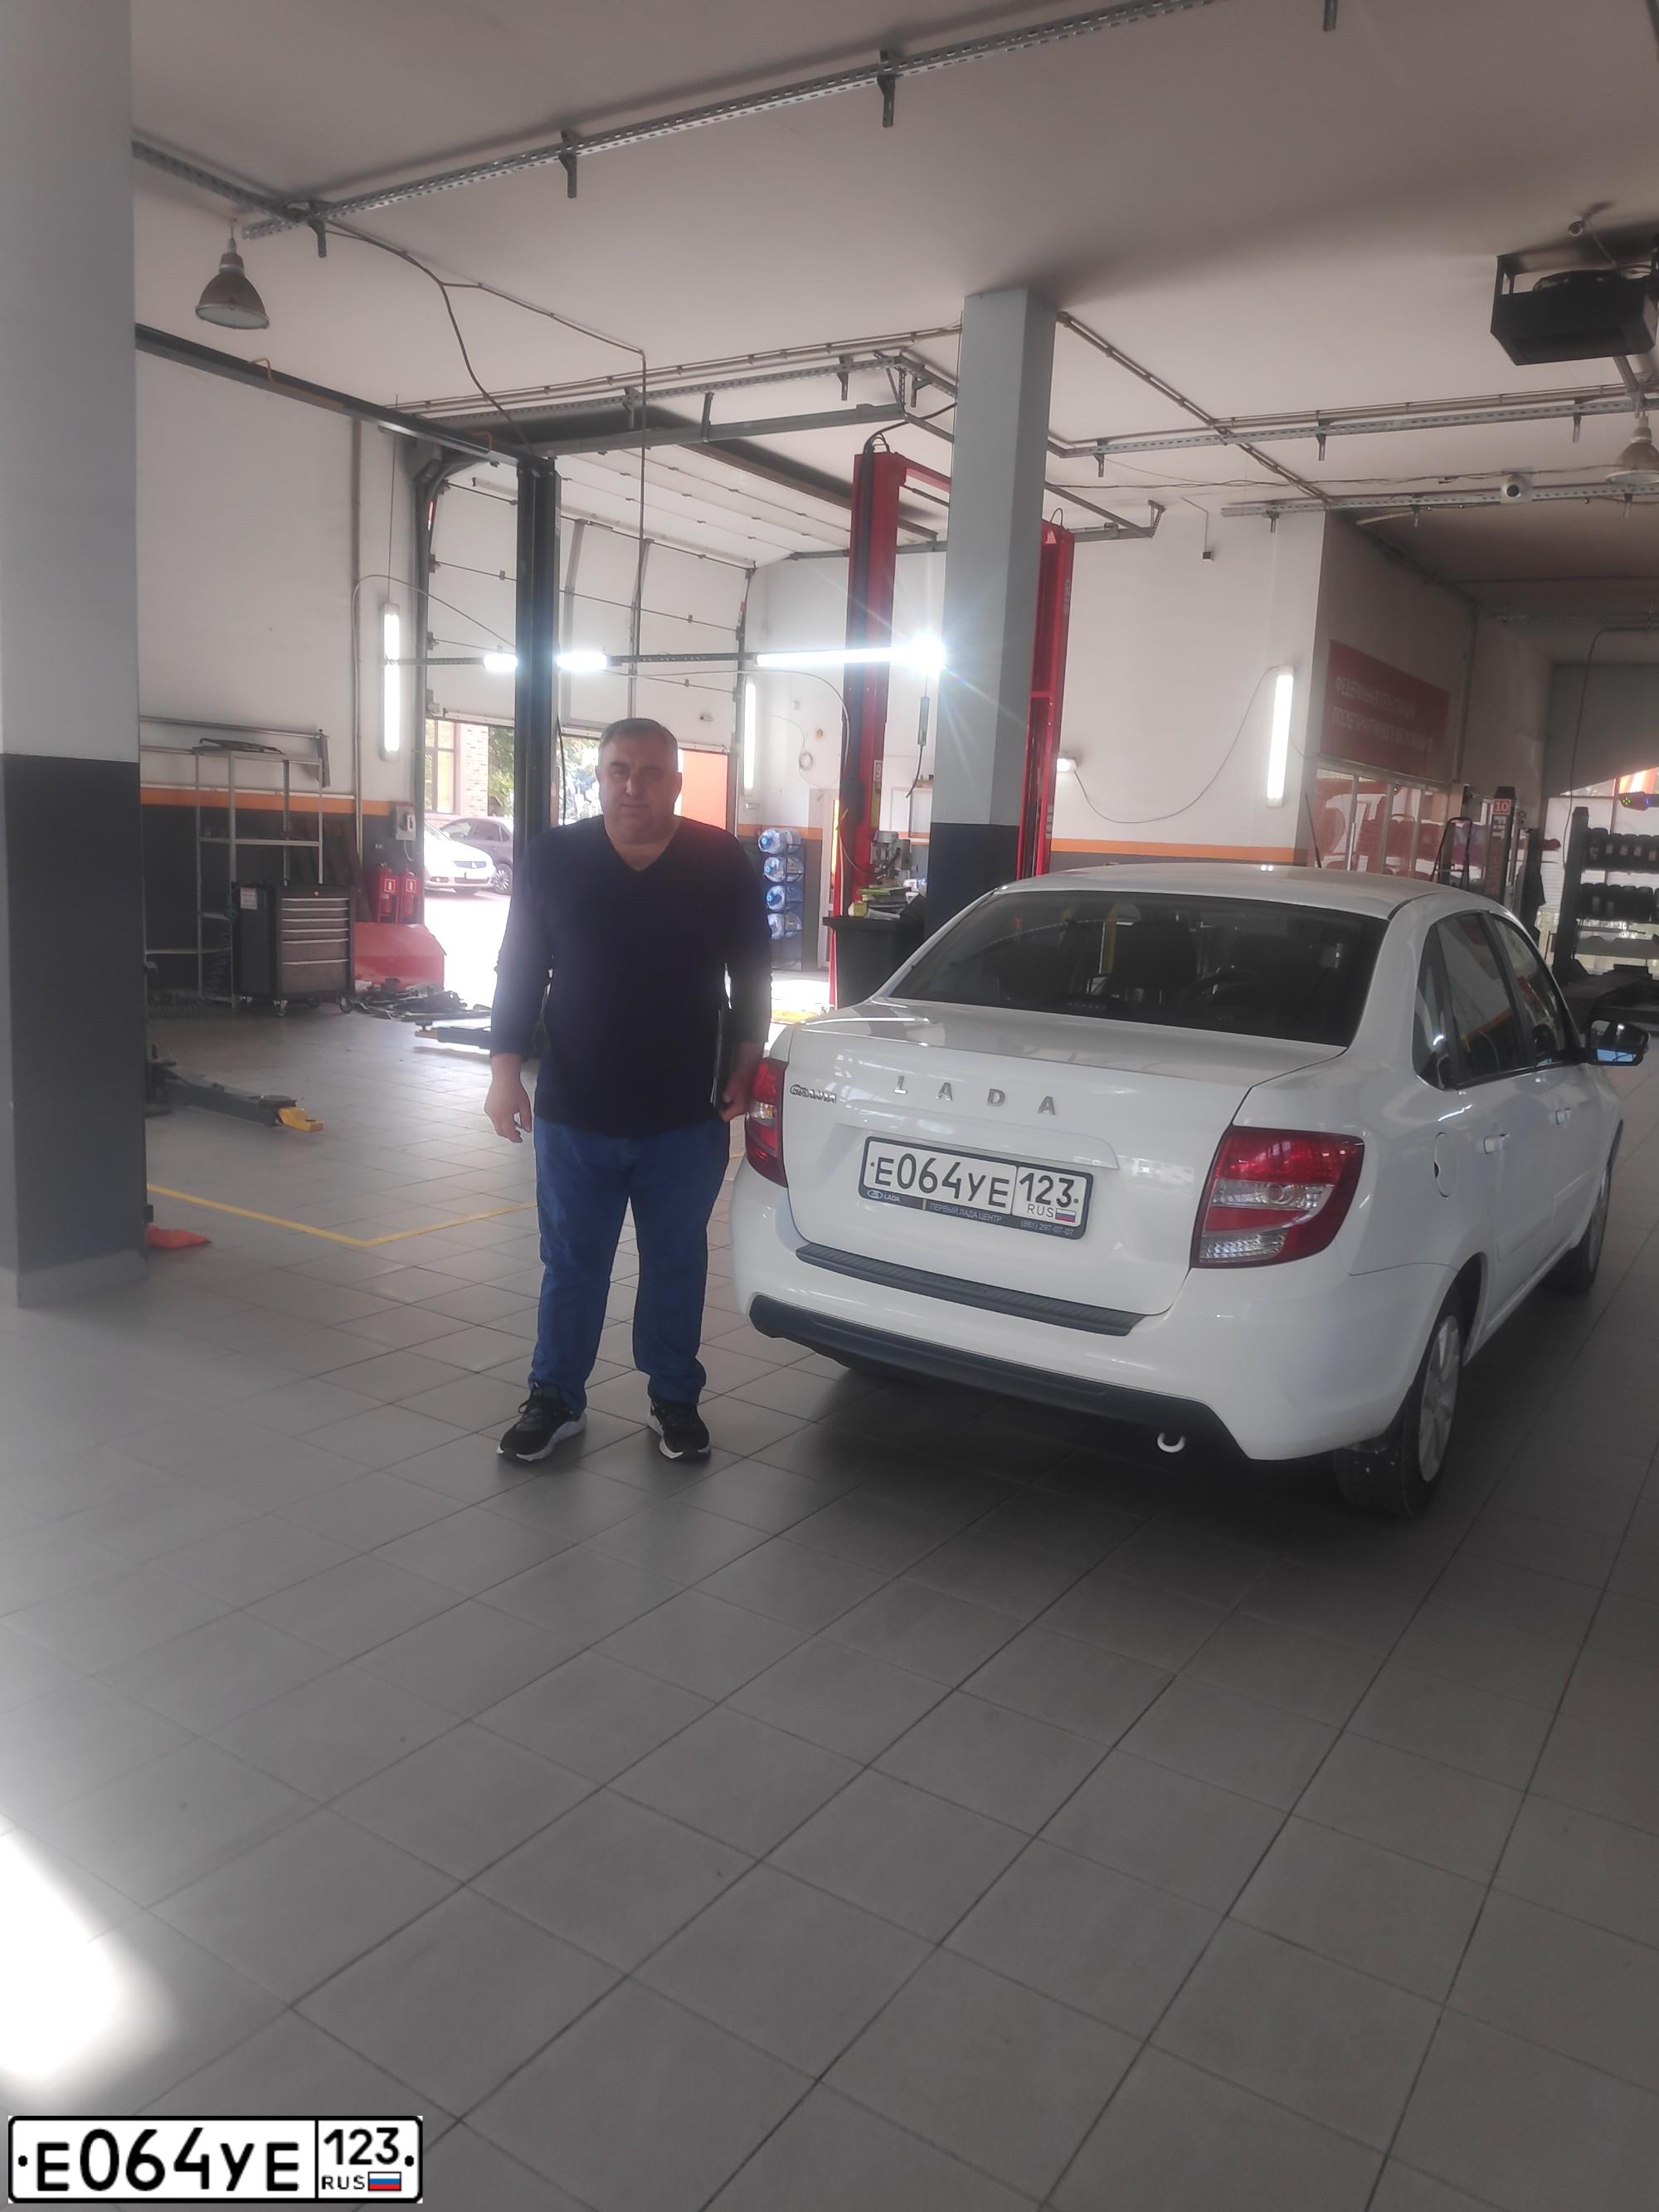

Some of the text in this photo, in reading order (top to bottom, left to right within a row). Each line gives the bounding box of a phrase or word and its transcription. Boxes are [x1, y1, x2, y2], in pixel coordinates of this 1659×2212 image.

[1495, 802, 1509, 812] 10
[894, 1076, 1056, 1115] LADA
[875, 1153, 1076, 1208] Е064УЕ 123
[883, 1193, 900, 1202] LADA
[929, 1202, 1002, 1222] ПЕРВЫЙ ЛАДА ЦЕНТР
[1027, 1203, 1054, 1218] RUS
